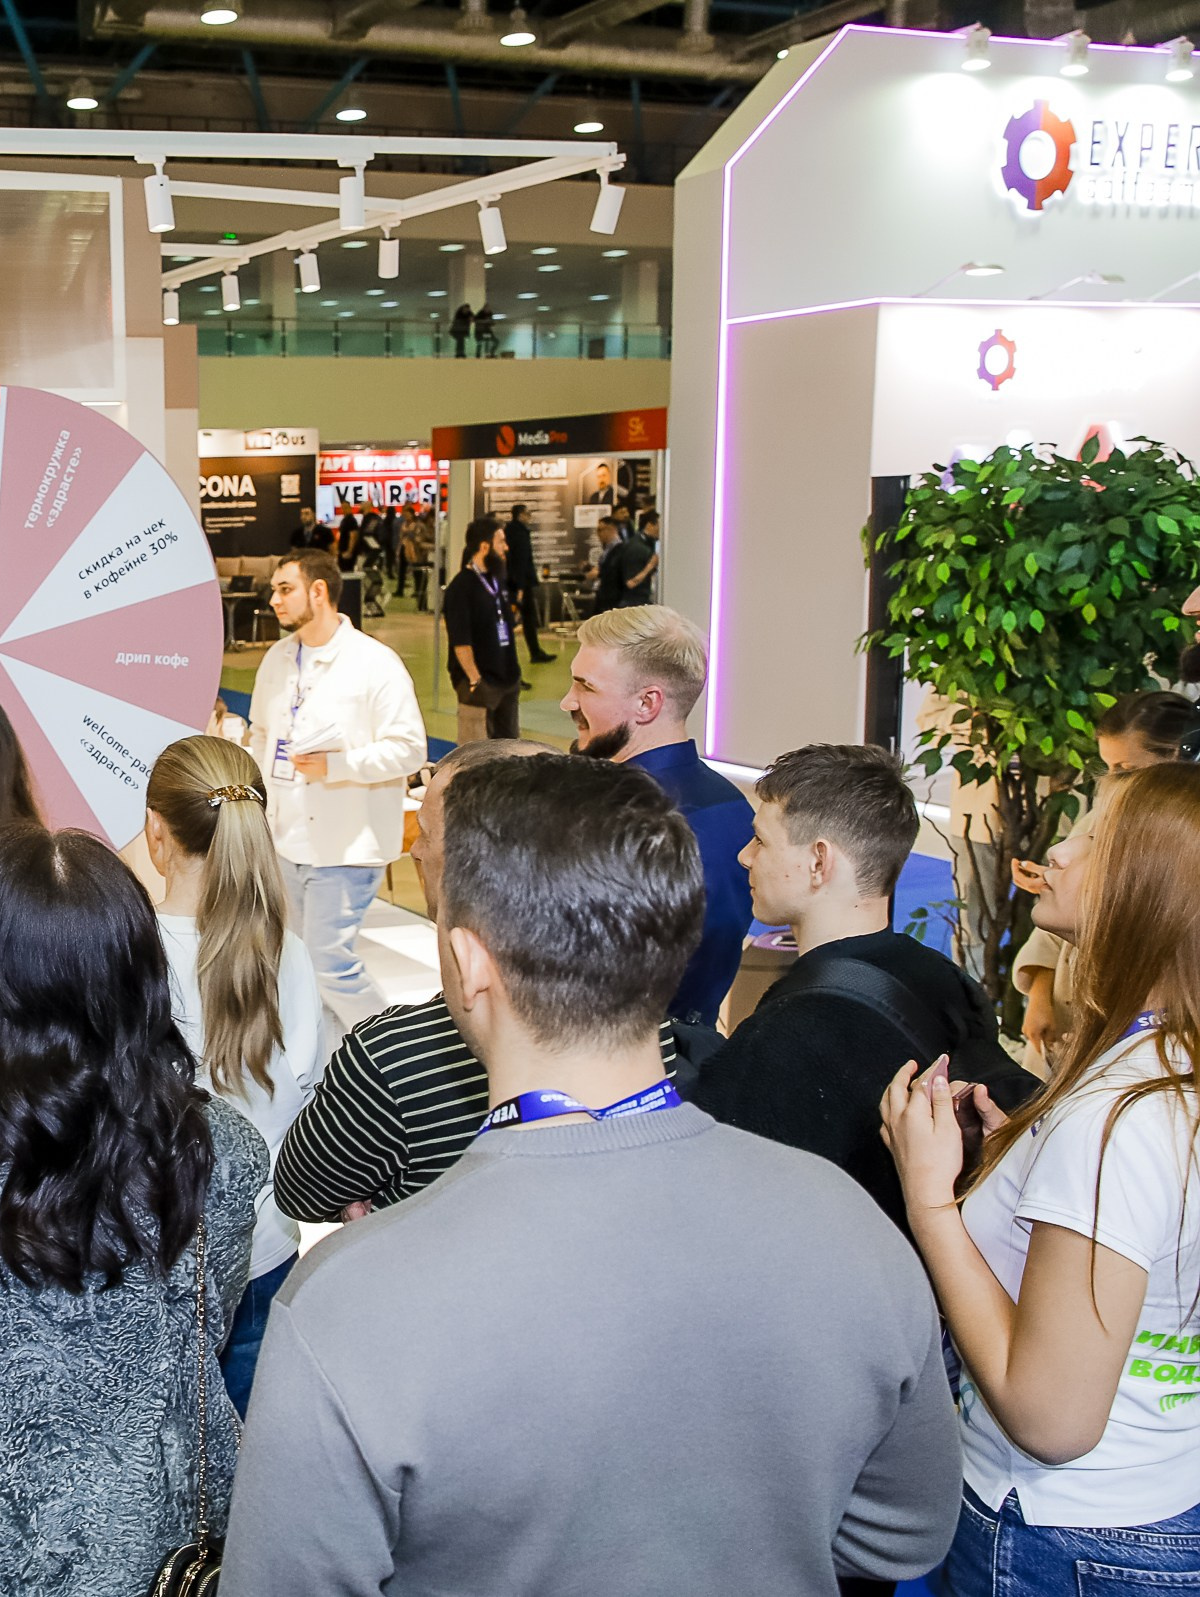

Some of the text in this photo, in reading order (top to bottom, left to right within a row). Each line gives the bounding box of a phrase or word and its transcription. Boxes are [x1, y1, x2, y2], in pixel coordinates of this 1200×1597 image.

[24, 429, 71, 529] термокружка
[46, 447, 82, 528] «здрасте»
[78, 518, 167, 580] скидка на чек
[83, 531, 179, 600] в кофейне 30%
[115, 652, 189, 669] дрип кофе
[79, 737, 140, 790] «здрасте»
